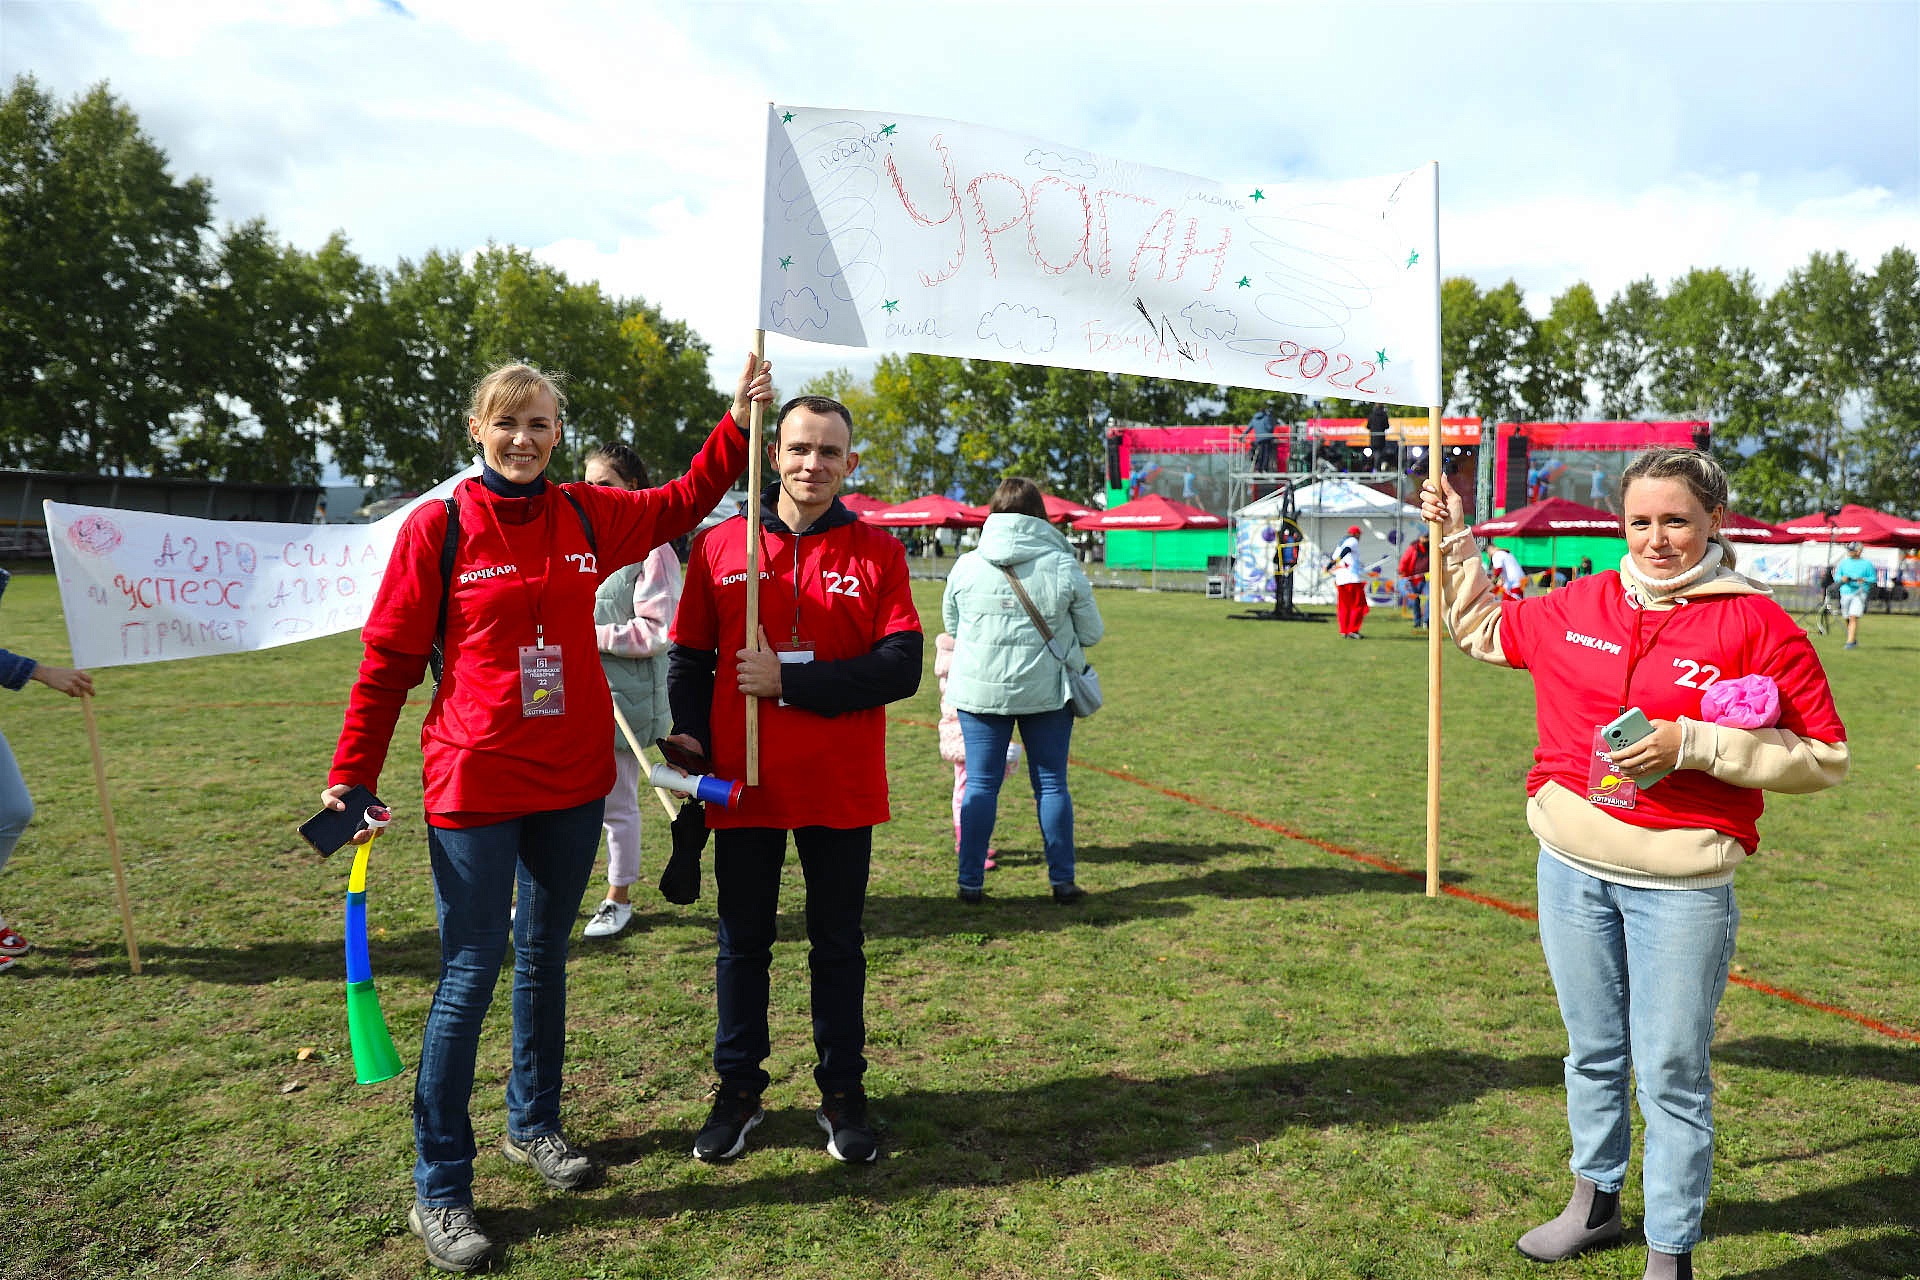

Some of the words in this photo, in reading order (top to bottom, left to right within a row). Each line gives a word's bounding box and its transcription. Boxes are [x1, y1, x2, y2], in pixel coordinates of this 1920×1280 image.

[1265, 340, 1378, 393] 2022
[822, 570, 860, 598] '22
[1565, 630, 1622, 655] БОЧКАРИ
[1672, 657, 1721, 691] '22
